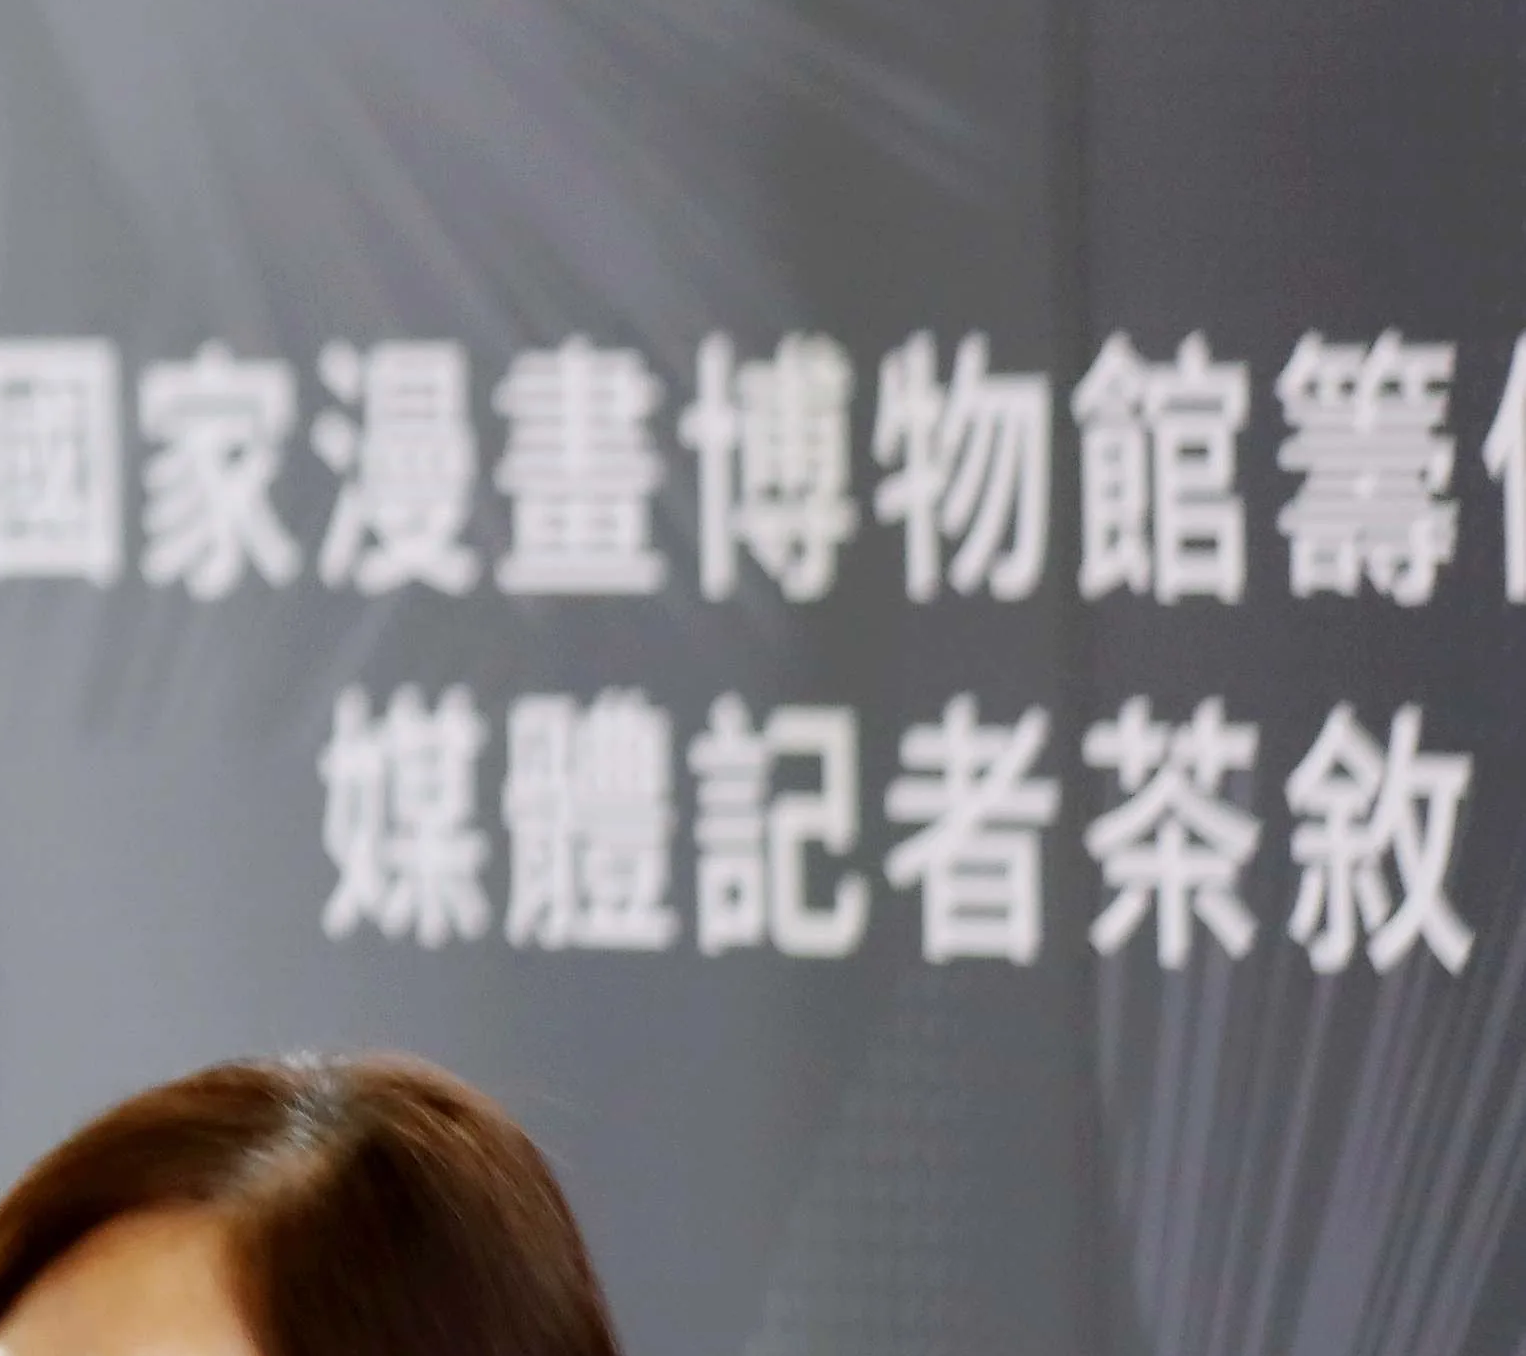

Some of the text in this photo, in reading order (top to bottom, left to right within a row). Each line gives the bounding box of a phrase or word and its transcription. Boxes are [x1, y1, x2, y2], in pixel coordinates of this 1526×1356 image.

[317, 682, 1476, 975] 媒體記者茶敘
